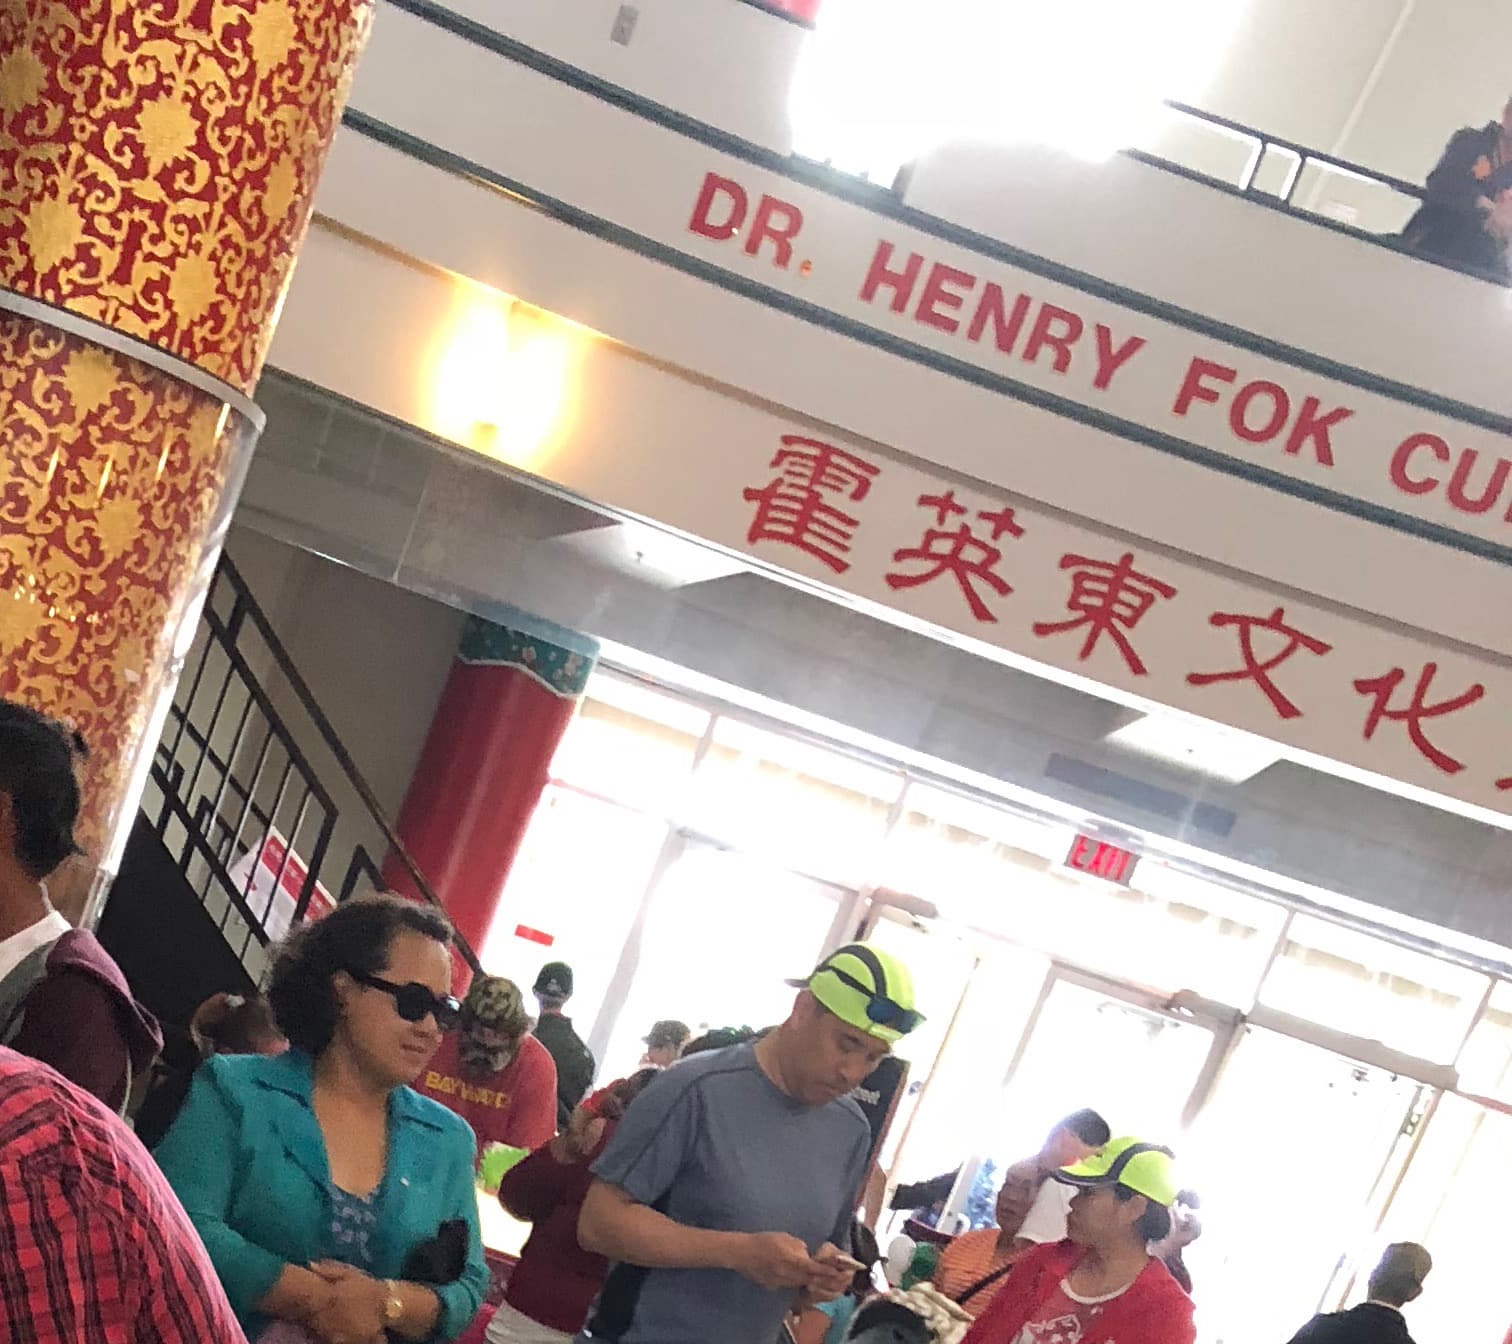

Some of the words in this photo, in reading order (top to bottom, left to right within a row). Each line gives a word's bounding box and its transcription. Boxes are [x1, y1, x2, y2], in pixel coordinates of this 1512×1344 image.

[688, 172, 814, 278] DR.
[859, 239, 1146, 391] HENRY
[1172, 357, 1352, 467] FOK
[1390, 433, 1512, 527] CU
[743, 435, 1512, 792] 霍英東文化
[1070, 834, 1131, 881] EXIT
